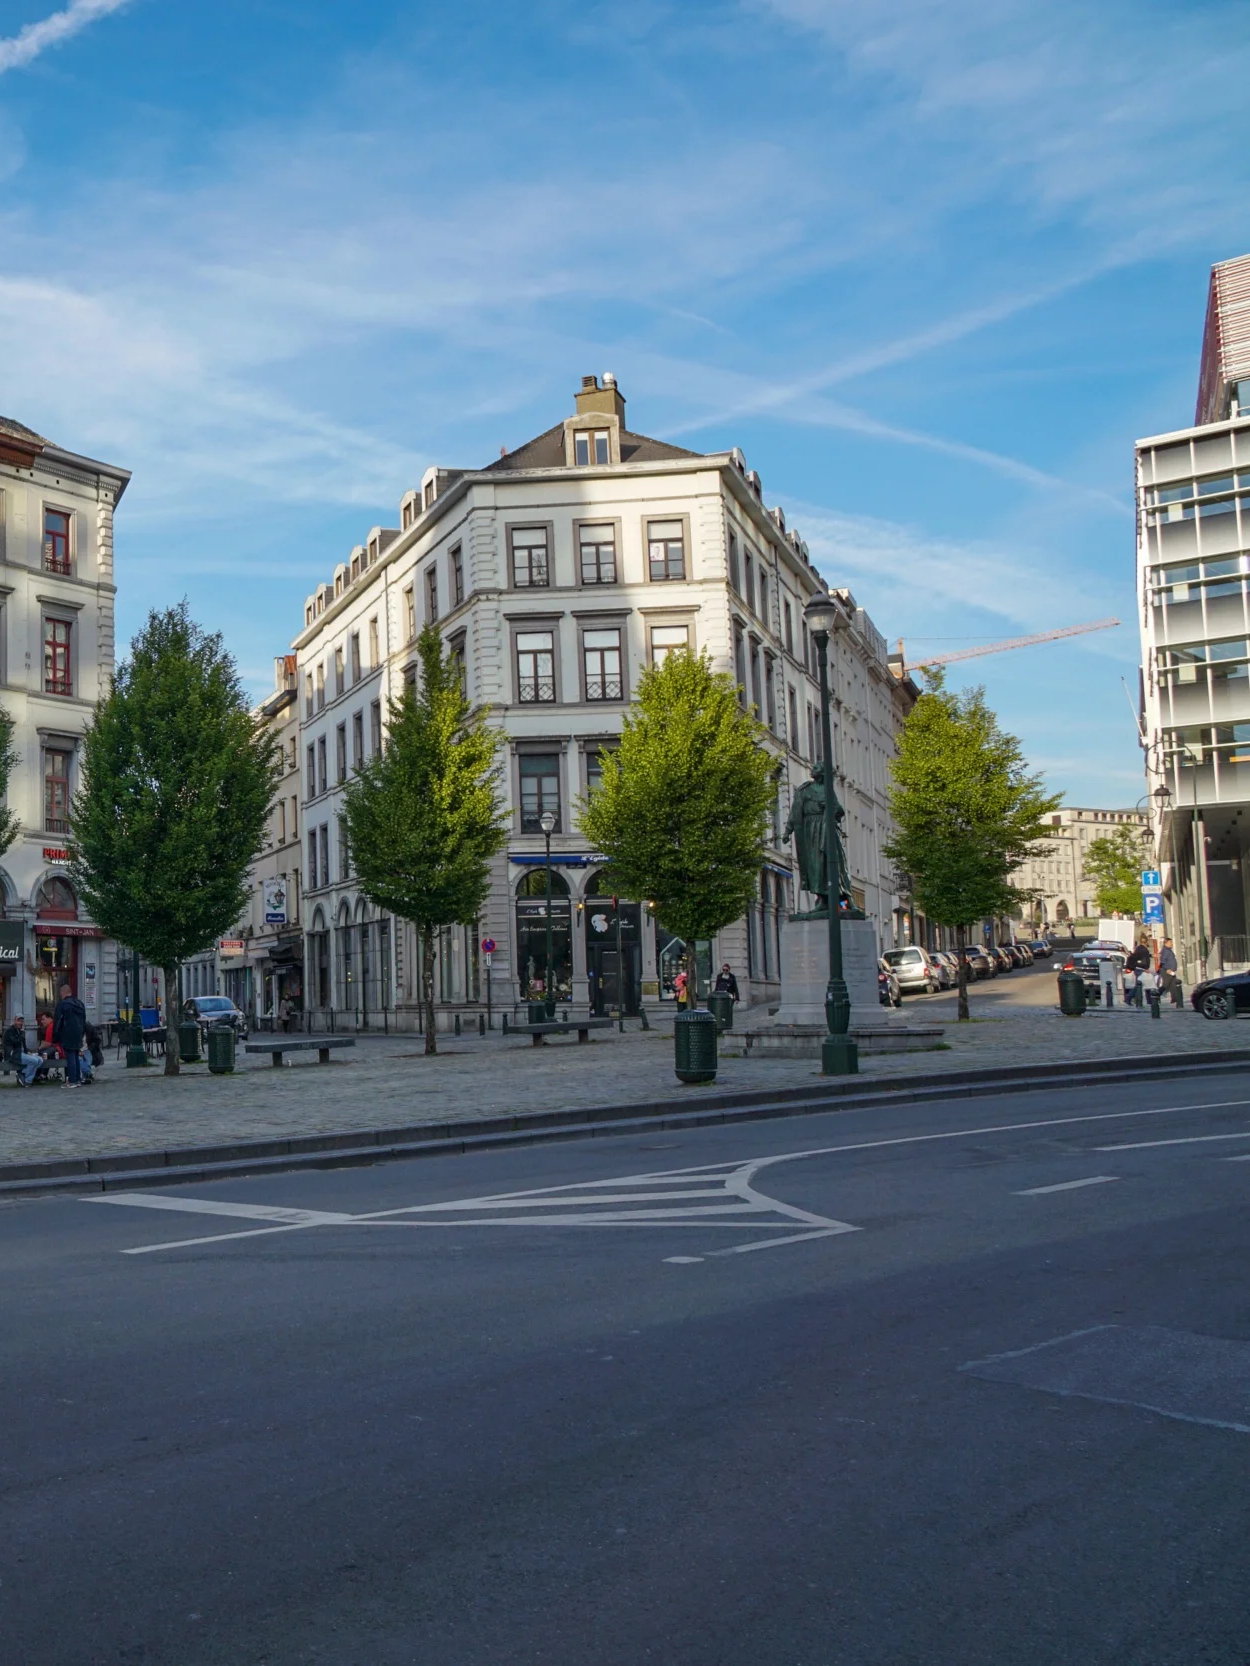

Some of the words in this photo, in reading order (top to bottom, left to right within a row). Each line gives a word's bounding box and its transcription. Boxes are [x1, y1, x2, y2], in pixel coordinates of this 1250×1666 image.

[43, 847, 70, 859] PRIM
[1145, 896, 1159, 913] P
[66, 928, 94, 936] SINT-JAN
